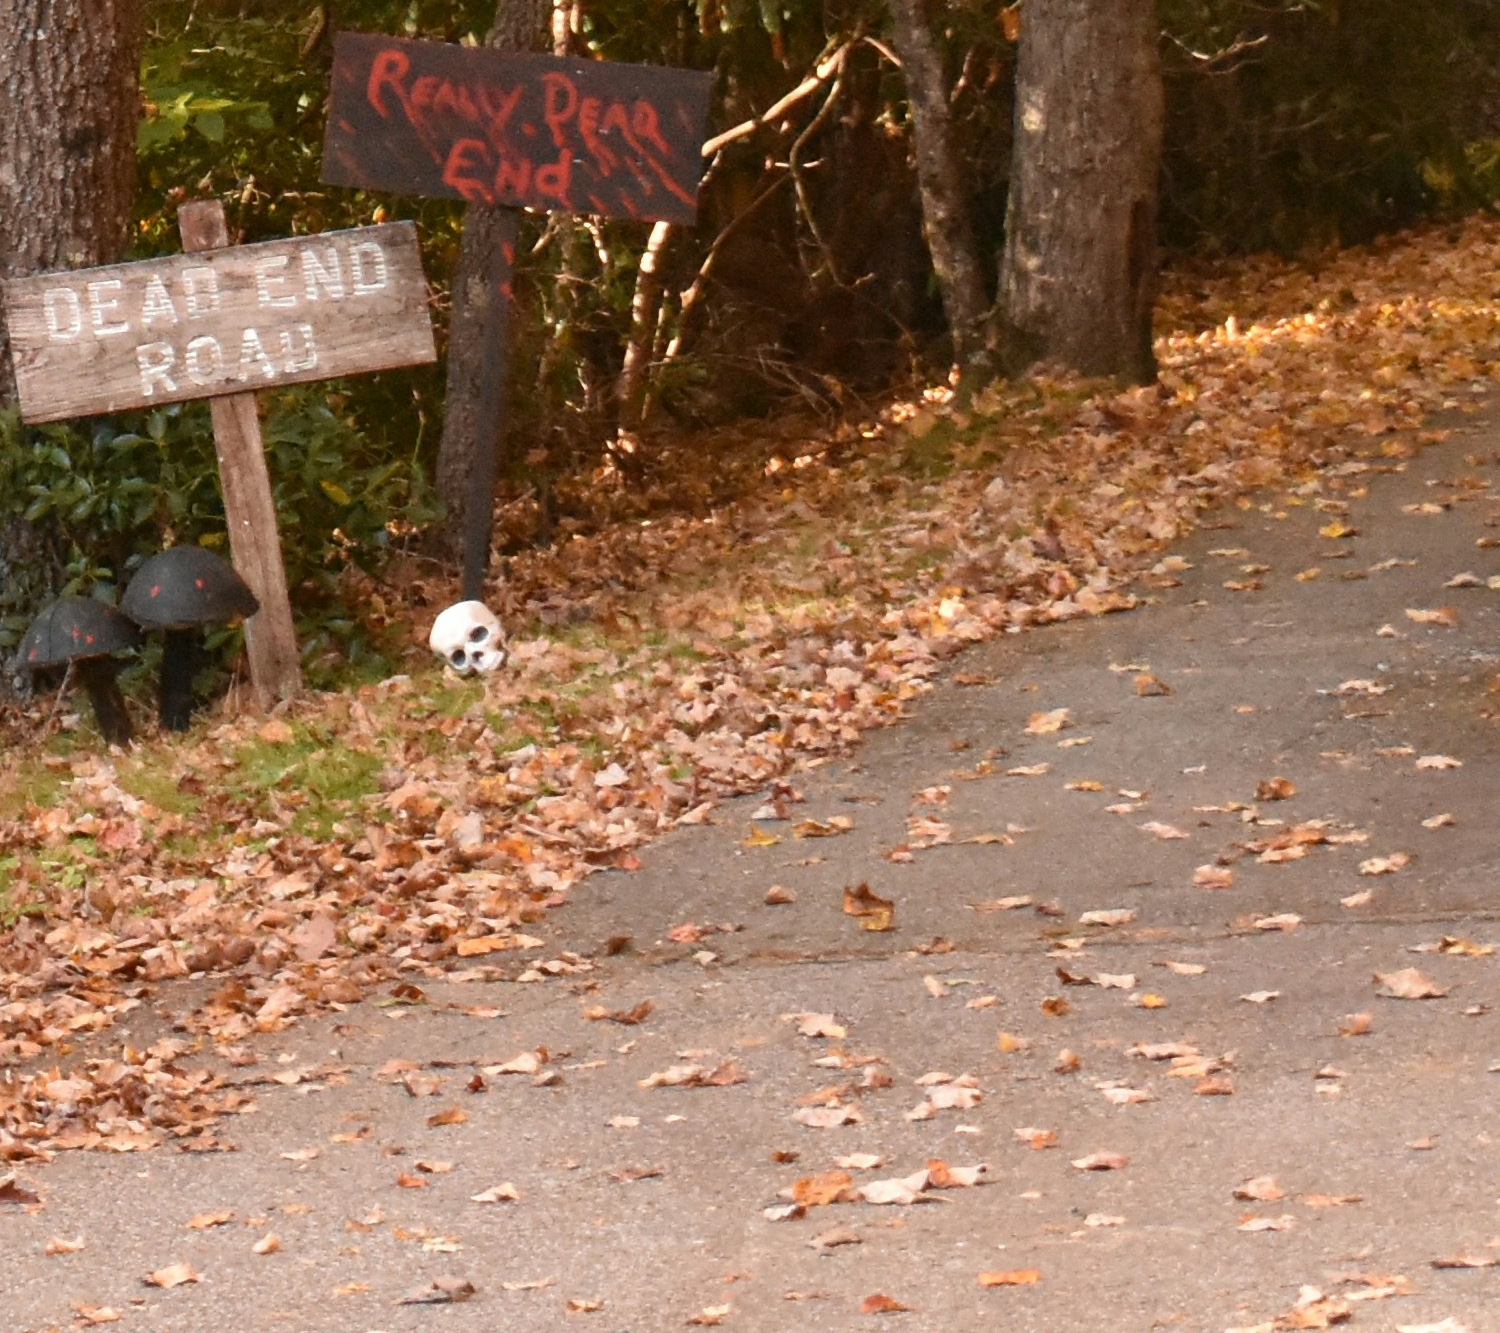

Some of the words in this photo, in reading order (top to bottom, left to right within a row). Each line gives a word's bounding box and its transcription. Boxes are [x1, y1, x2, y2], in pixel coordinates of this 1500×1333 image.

[43, 267, 221, 342] DEAD
[254, 240, 388, 308] END
[135, 323, 319, 397] ROAD
